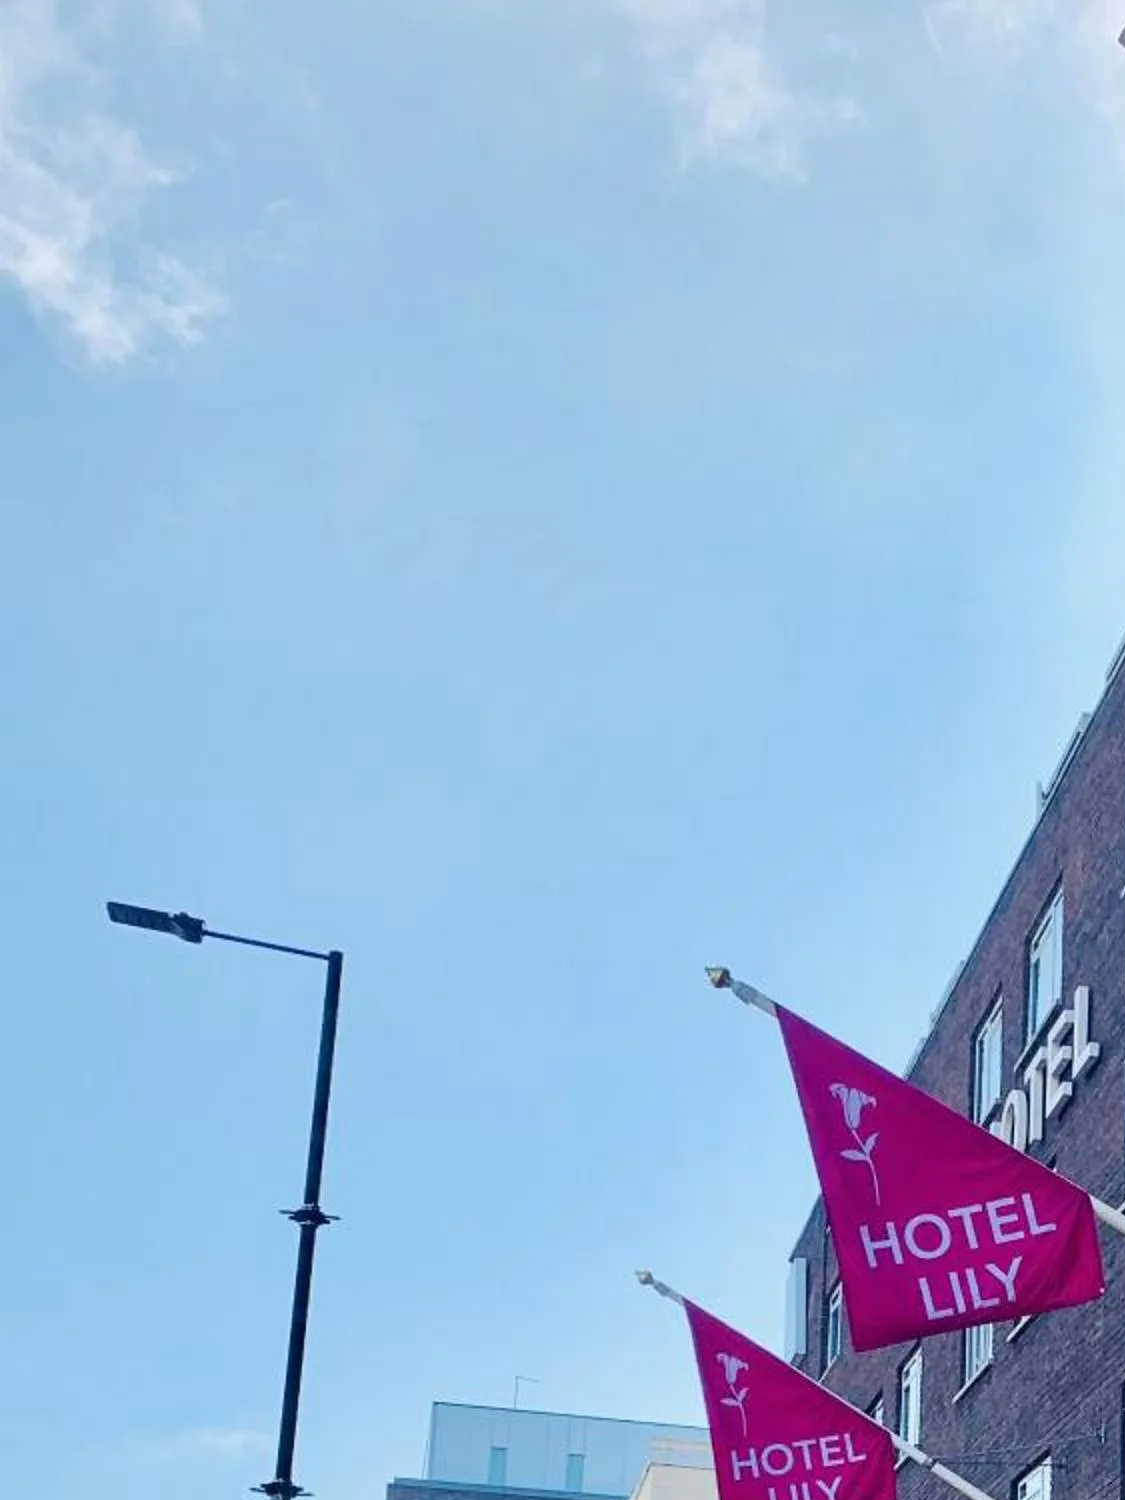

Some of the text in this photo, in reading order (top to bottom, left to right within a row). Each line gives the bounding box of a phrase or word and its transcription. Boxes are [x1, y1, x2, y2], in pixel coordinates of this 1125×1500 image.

[989, 985, 1099, 1153] OTEL
[859, 1192, 1057, 1268] HOTEL
[917, 1255, 1023, 1321] LILY
[730, 1433, 867, 1481] HOTEL
